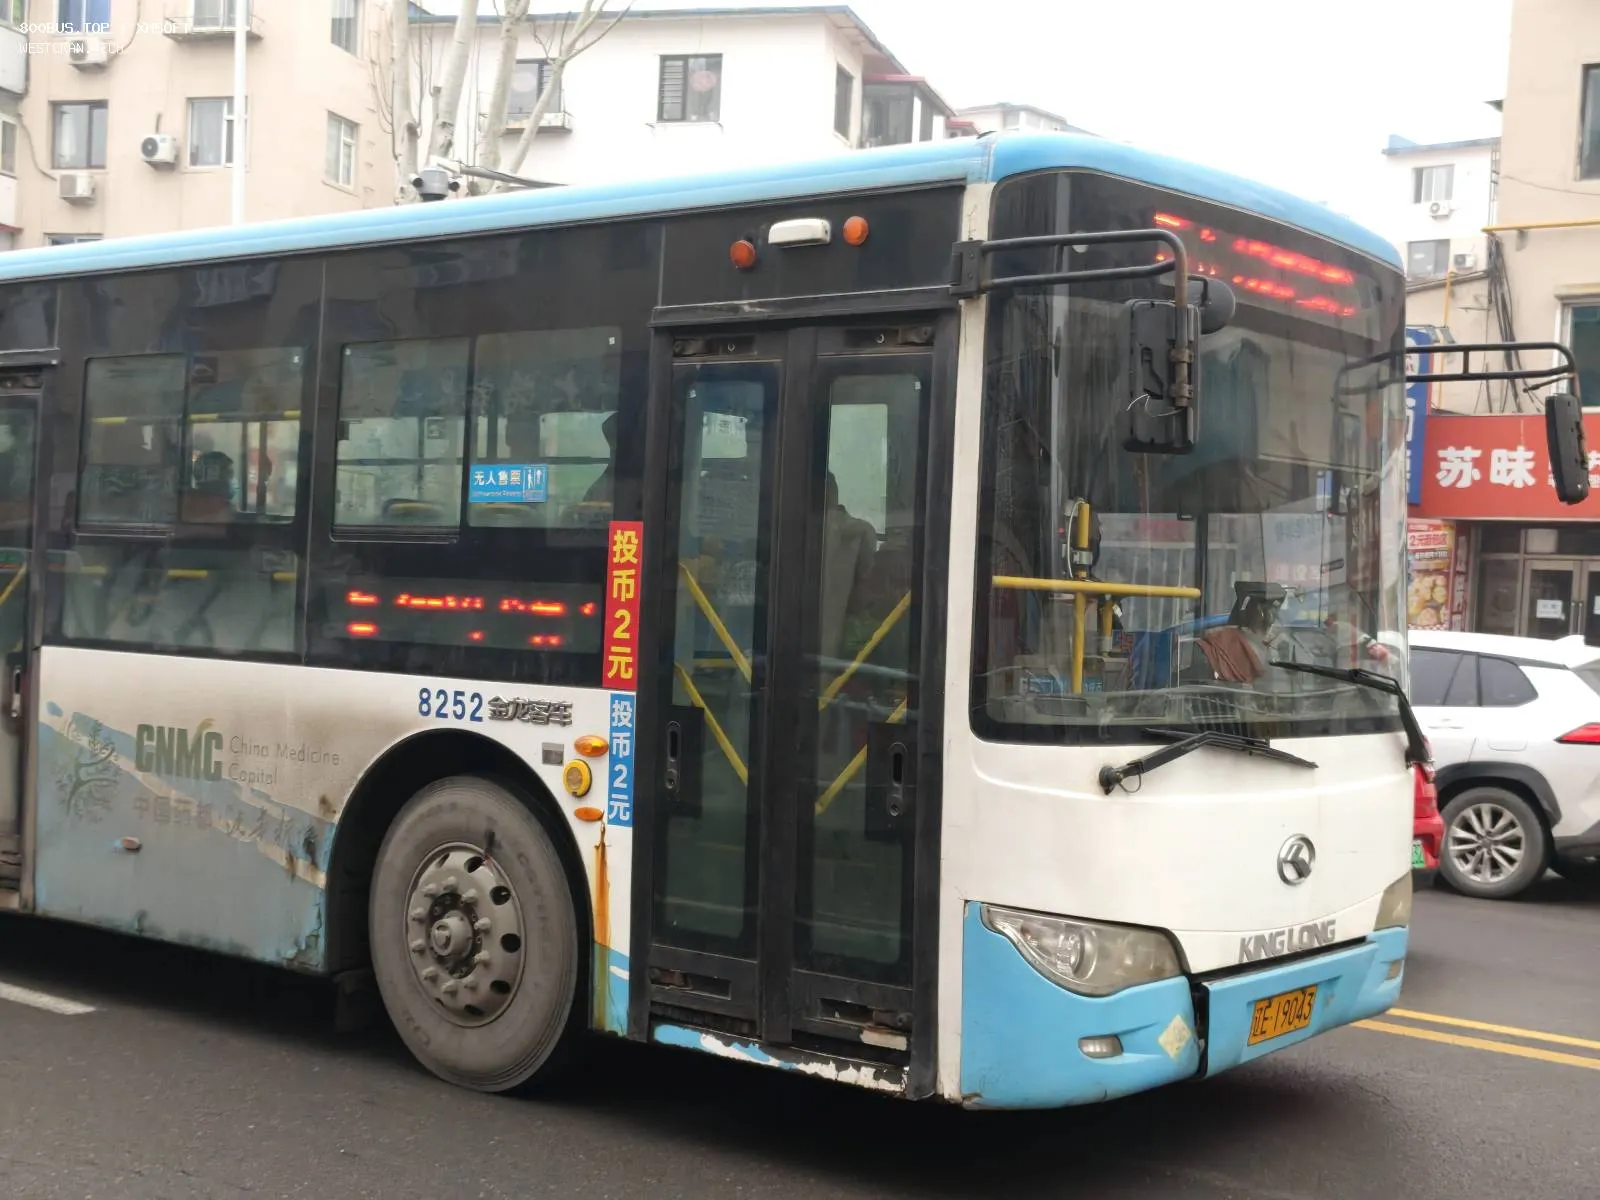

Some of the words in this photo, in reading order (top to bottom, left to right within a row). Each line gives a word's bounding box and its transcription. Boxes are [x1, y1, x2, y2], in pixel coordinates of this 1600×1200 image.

[1435, 445, 1600, 489] 苏味
[608, 529, 639, 679] 投币2元
[418, 687, 484, 722] 8252
[135, 719, 223, 781] CNMC
[229, 735, 270, 757] China
[276, 742, 341, 766] Medicine
[608, 699, 633, 822] 投币2元
